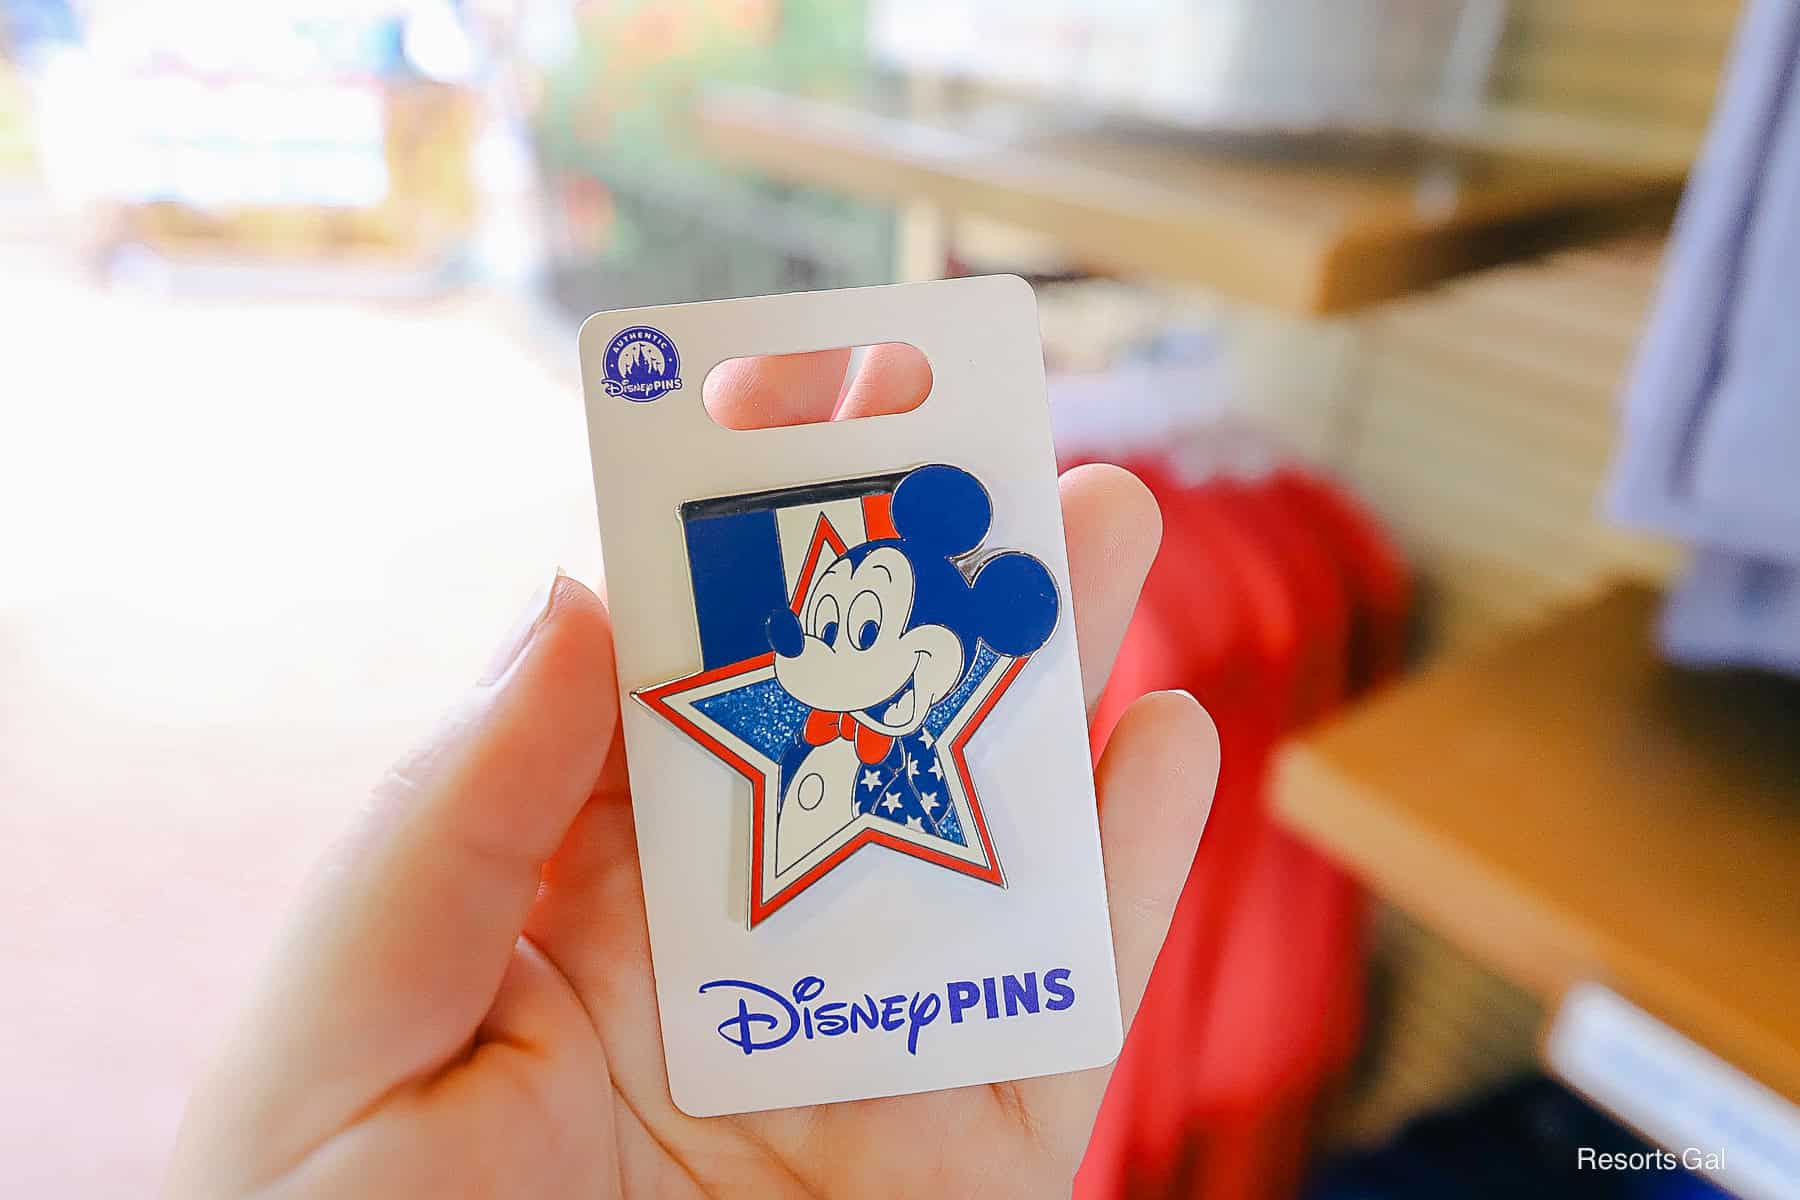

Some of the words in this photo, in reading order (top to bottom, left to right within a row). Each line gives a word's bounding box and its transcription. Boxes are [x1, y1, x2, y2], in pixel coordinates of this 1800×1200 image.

[613, 332, 668, 353] AUTHENTIC
[653, 378, 682, 391] PINS
[946, 968, 1076, 1024] PINS
